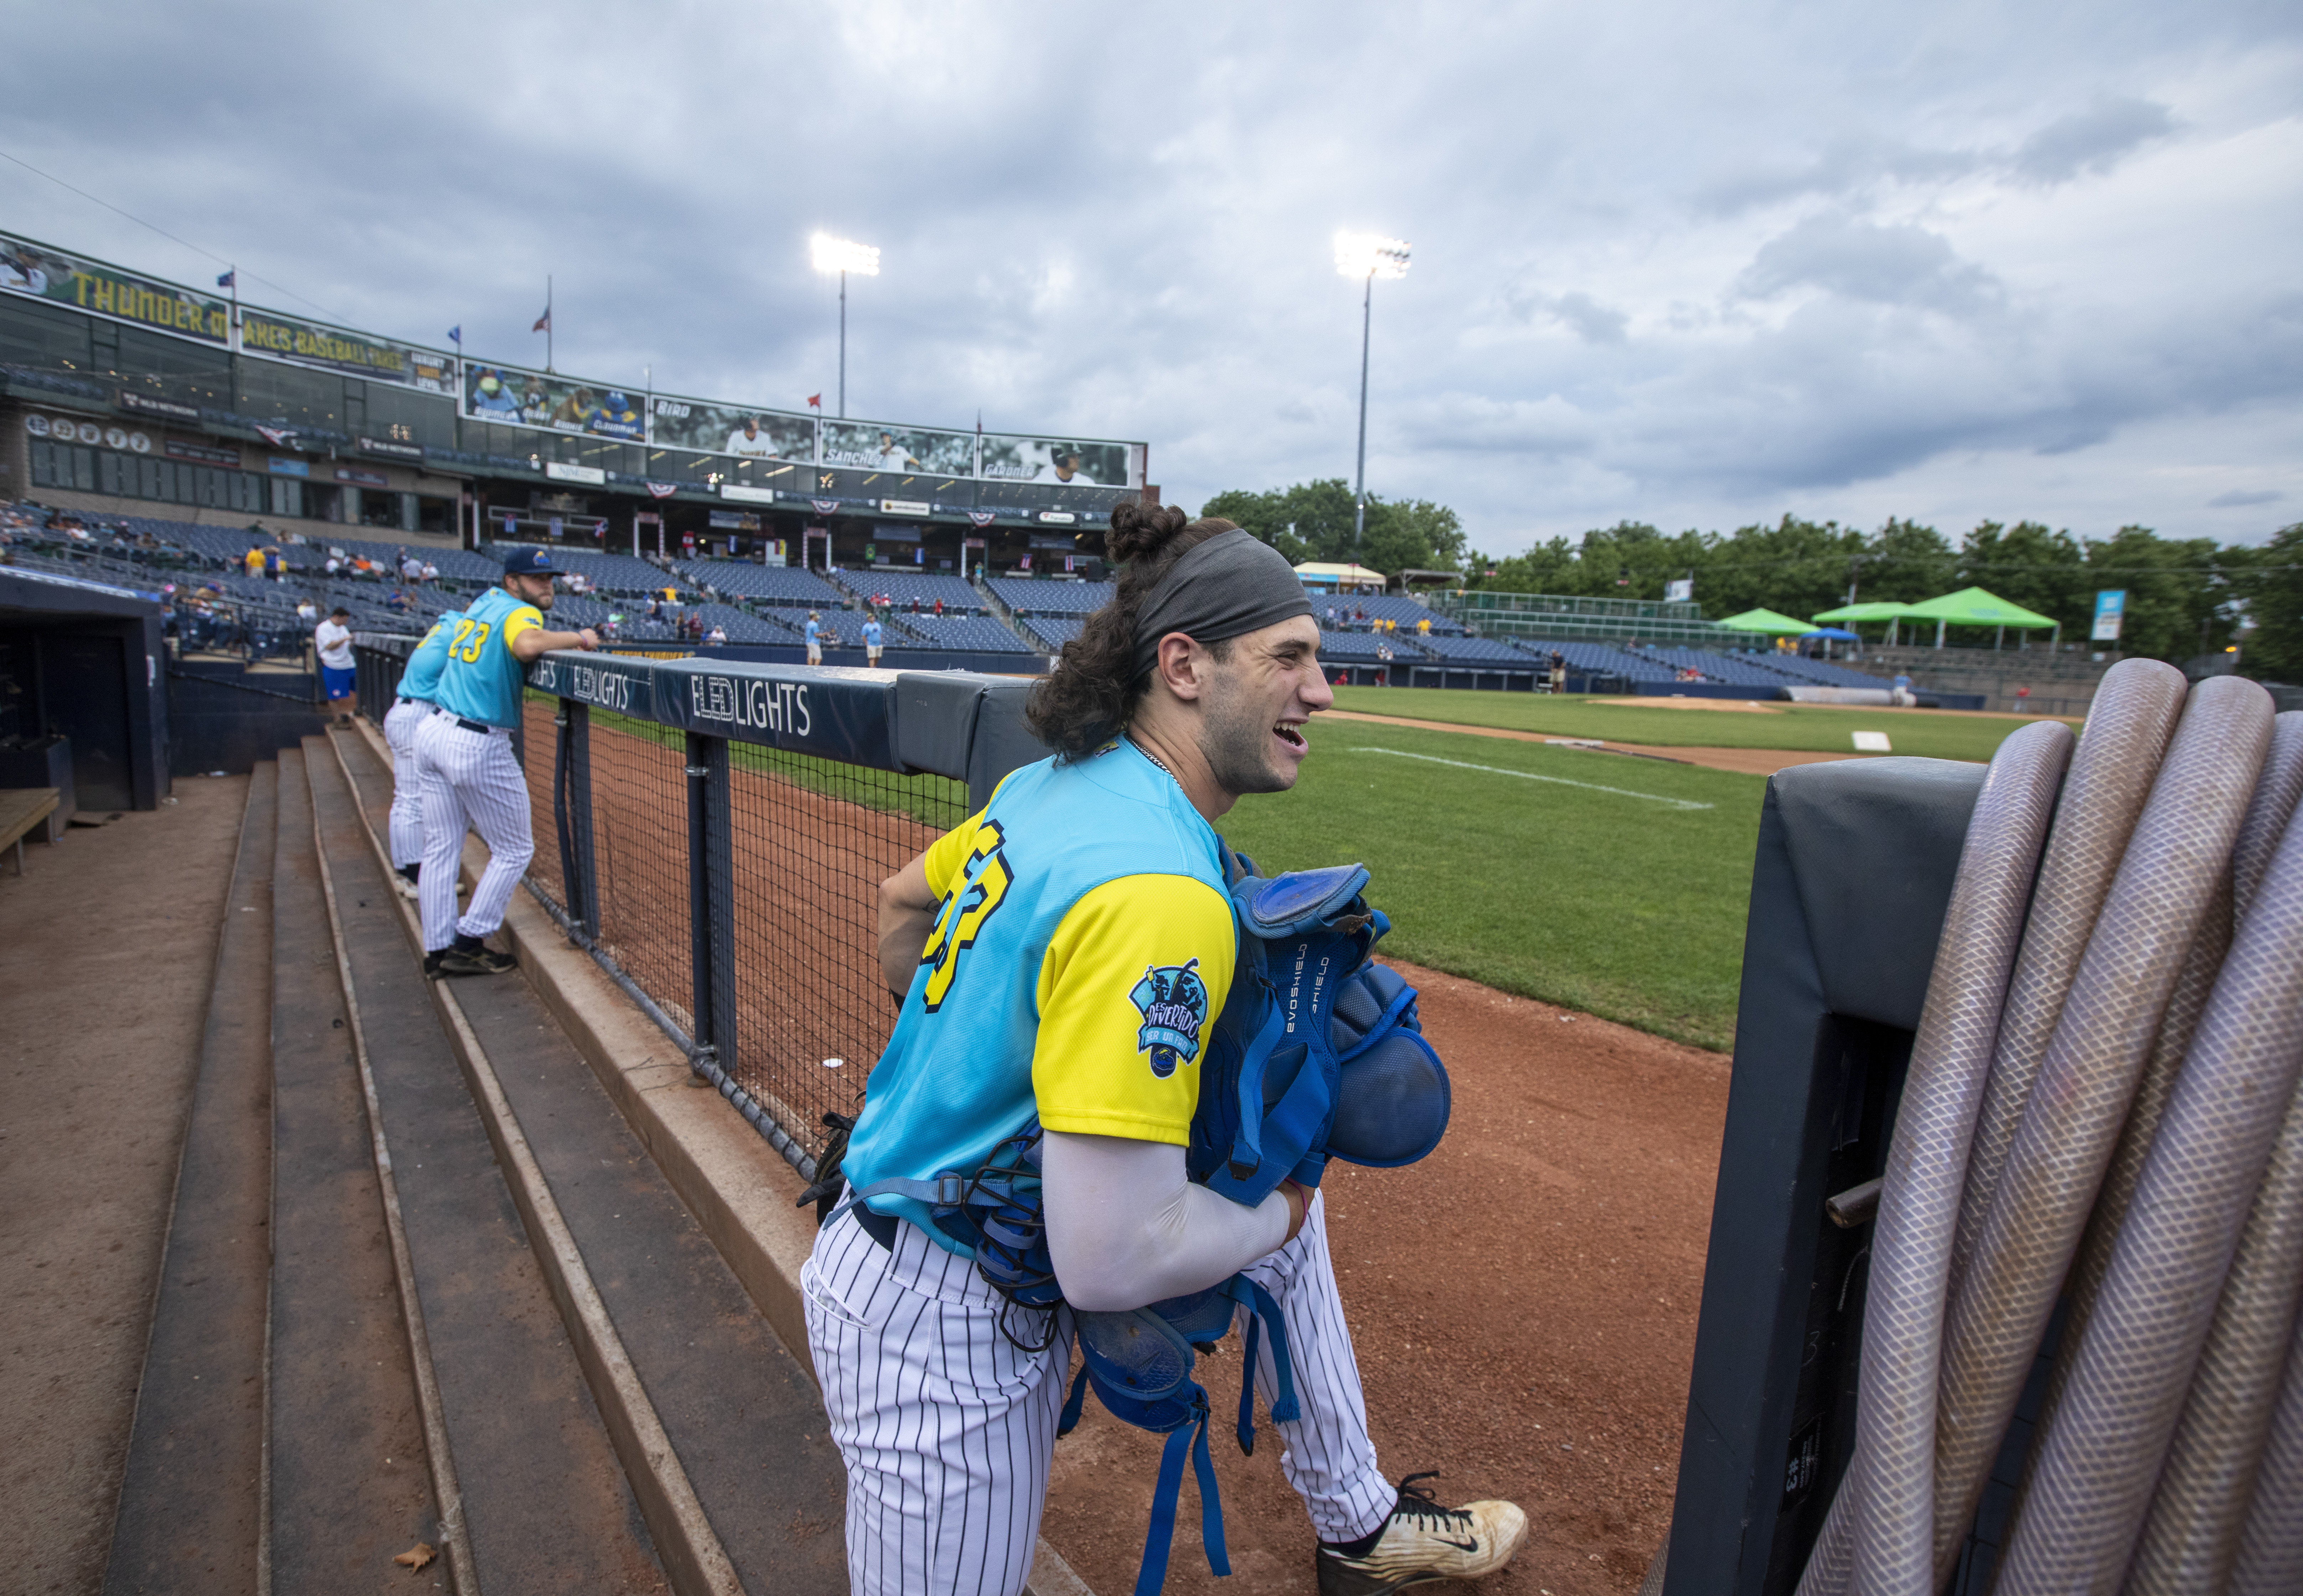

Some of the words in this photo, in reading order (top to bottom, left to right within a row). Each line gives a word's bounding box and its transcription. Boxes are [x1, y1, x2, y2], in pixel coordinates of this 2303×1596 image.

[73, 272, 203, 334] THUNDER
[296, 331, 368, 365] BASEBALL
[656, 400, 691, 418] BIRD
[826, 448, 883, 465] SANCHEZ
[985, 463, 1034, 477] GARDNER
[448, 618, 491, 664] 23
[1155, 1002, 1167, 1012] ES
[1146, 1031, 1160, 1042] SER
[1174, 1035, 1188, 1051] FAN
[1786, 1457, 1799, 1492] #3
